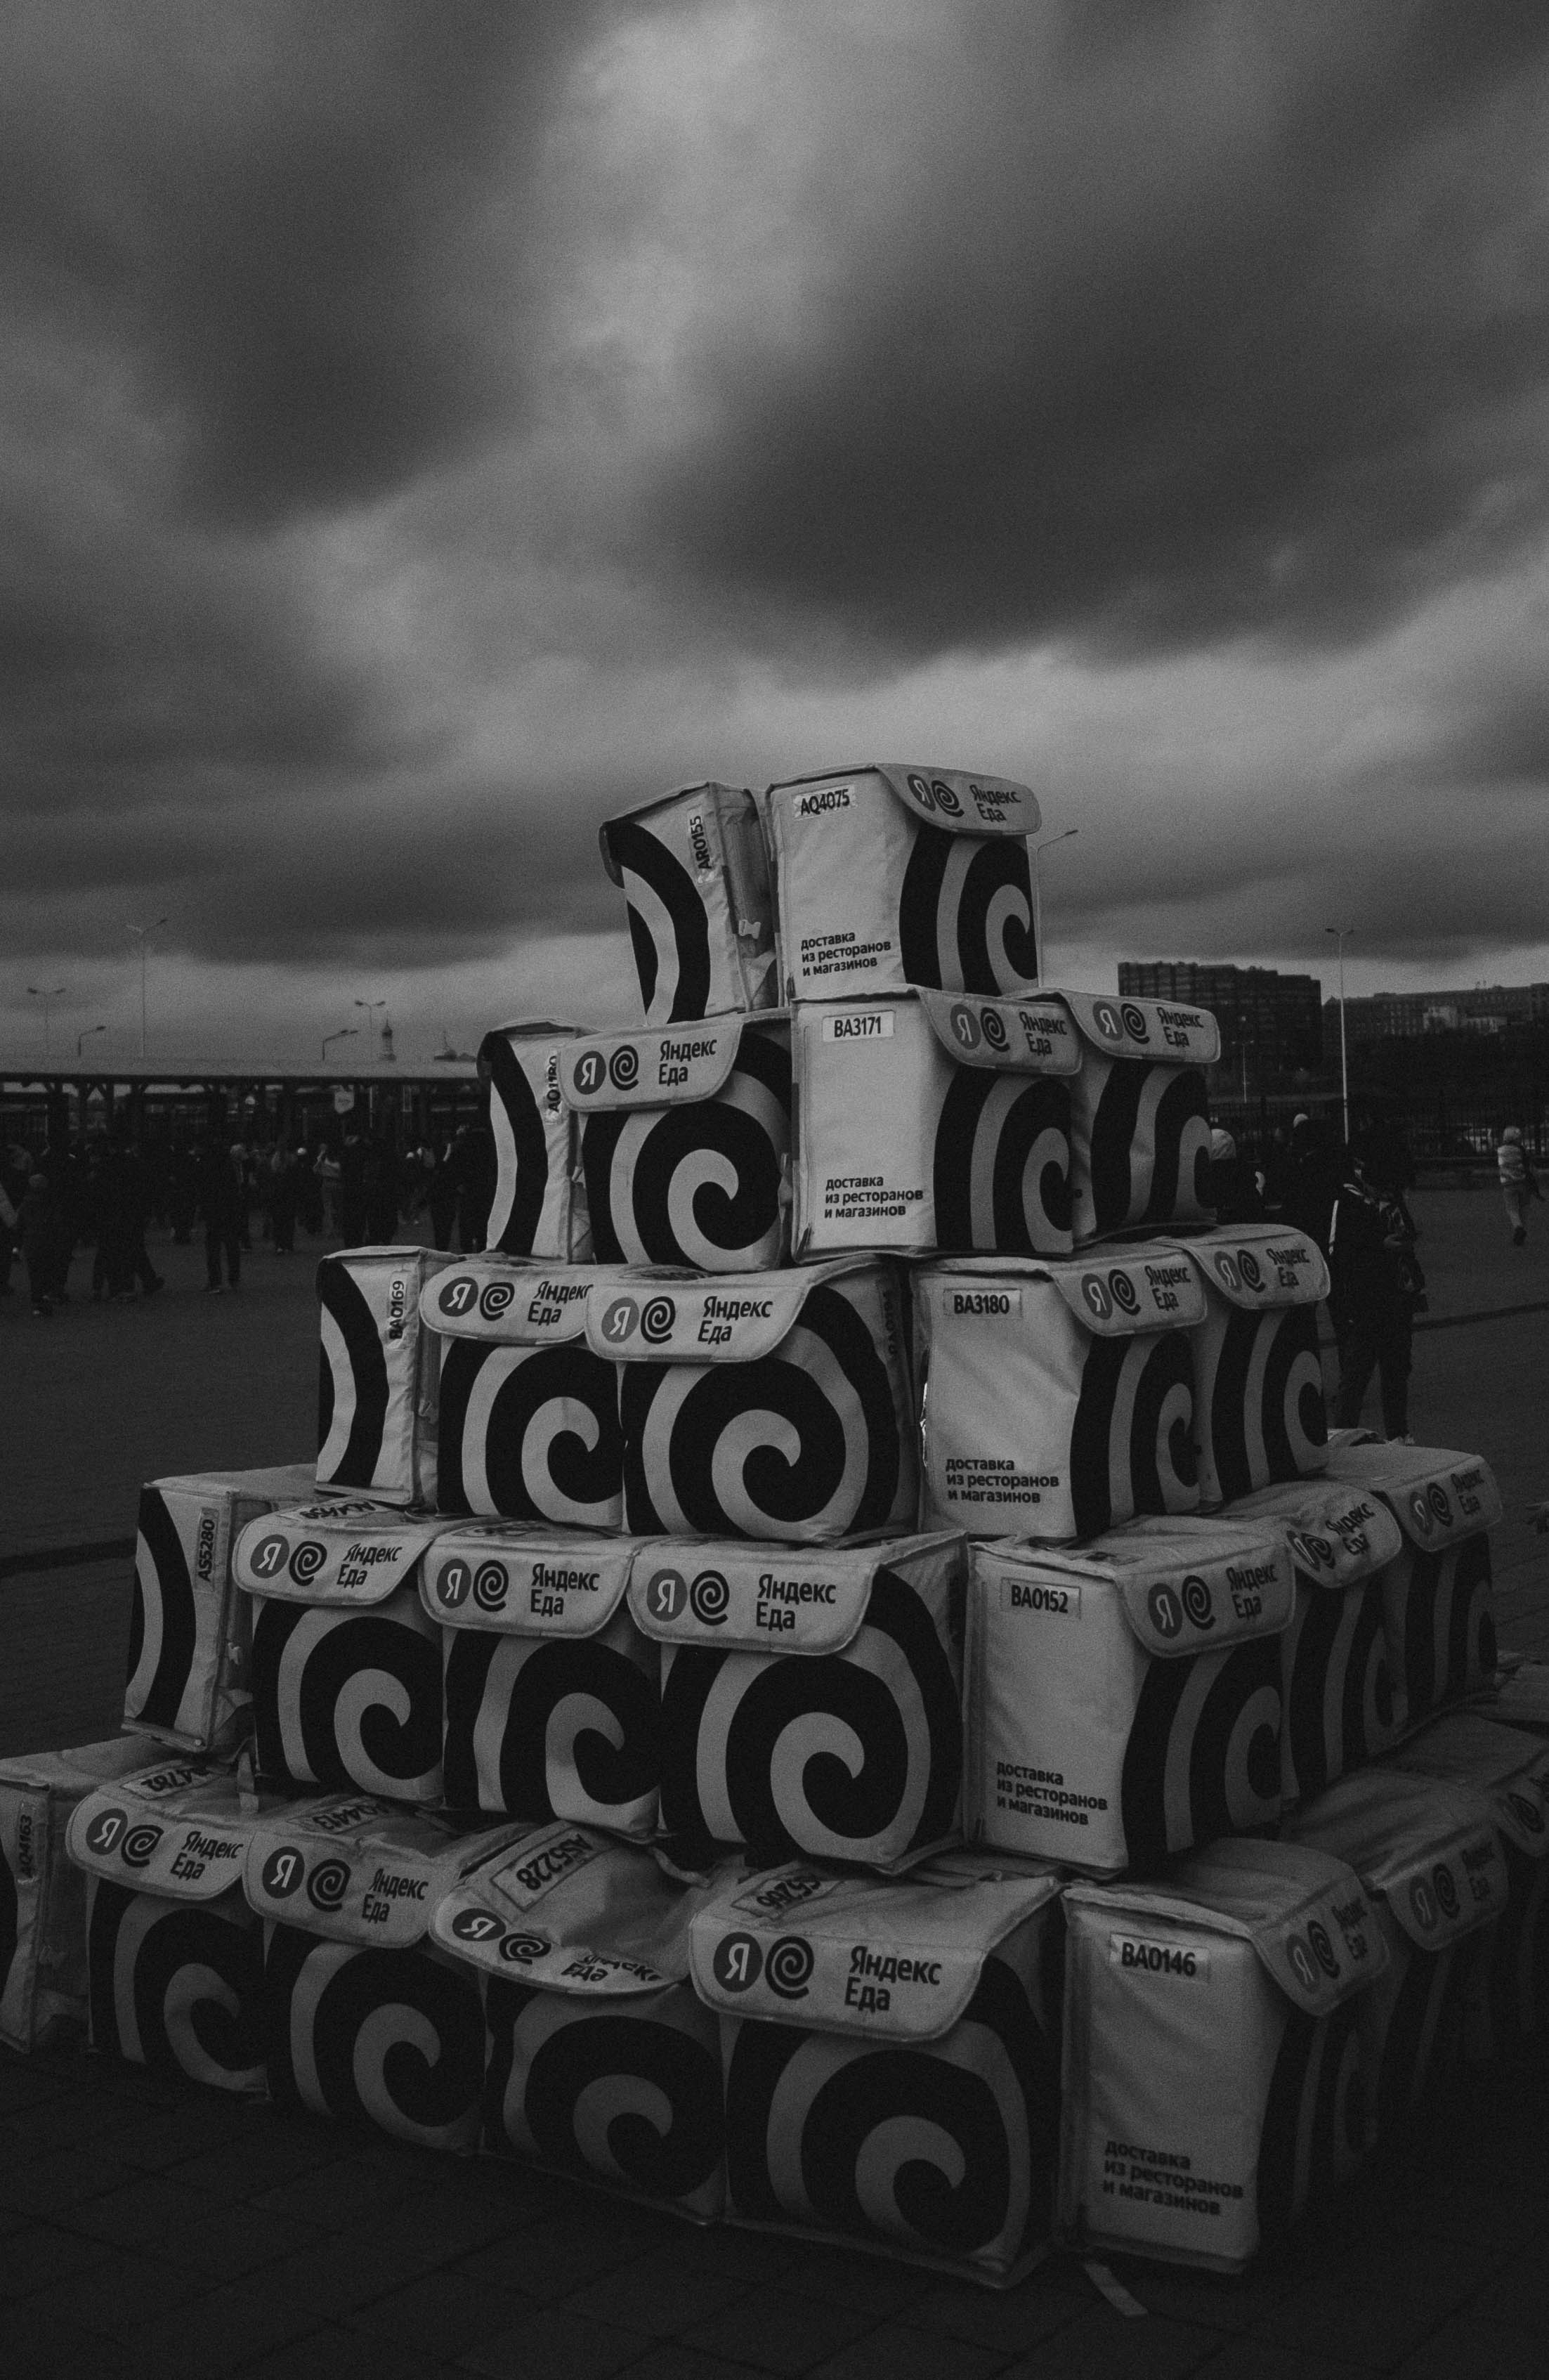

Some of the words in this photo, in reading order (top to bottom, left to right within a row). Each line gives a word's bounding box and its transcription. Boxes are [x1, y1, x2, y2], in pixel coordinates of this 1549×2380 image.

[800, 788, 850, 817] AQ4075
[969, 785, 1021, 807] Яндекс
[979, 806, 1005, 823] Еда
[690, 815, 712, 870] AR0155
[801, 932, 856, 950] доставка
[802, 951, 814, 963] из
[817, 939, 891, 961] ресторанов
[802, 965, 810, 977] и
[812, 956, 877, 975] магазинов
[833, 1016, 882, 1038] BA3171
[1019, 1011, 1068, 1036] Яндекс
[1156, 1007, 1204, 1030] Яндекс
[1027, 1033, 1052, 1054] Еда
[1163, 1026, 1189, 1048] Еда
[659, 1039, 717, 1062] Яндекс
[658, 1063, 688, 1084] Еда
[825, 1176, 884, 1192] доставка
[825, 1192, 839, 1204] из
[842, 1188, 923, 1207] ресторанов
[824, 1207, 832, 1218] и
[835, 1204, 906, 1219] магазинов
[1267, 1247, 1309, 1270] Яндекс
[1144, 1266, 1191, 1290] Яндекс
[1279, 1268, 1300, 1287] Еда
[703, 1296, 773, 1321] Яндекс
[954, 1294, 1009, 1314] BA3180
[1152, 1288, 1179, 1311] Еда
[528, 1301, 562, 1326] Еда
[698, 1321, 732, 1344] Еда
[946, 1457, 1015, 1473] доставка
[947, 1474, 962, 1487] из
[967, 1474, 1059, 1491] ресторанов
[948, 1490, 957, 1501] и
[961, 1490, 1040, 1504] магазинов
[199, 1519, 215, 1582] AS5280
[344, 1543, 404, 1566] Яндекс
[336, 1563, 367, 1587] Еда
[531, 1563, 600, 1594] Яндекс
[1226, 1561, 1278, 1597] Яндекс
[757, 1574, 837, 1604] Яндекс
[1011, 1585, 1068, 1613] BA0152
[530, 1589, 564, 1616] Еда
[1234, 1594, 1262, 1620] Еда
[756, 1601, 796, 1631] Еда
[997, 1761, 1064, 1786] доставка
[997, 1779, 1013, 1793] из
[1017, 1782, 1108, 1811] ресторанов
[997, 1794, 1006, 1807] и
[1009, 1797, 1089, 1826] магазинов
[183, 1830, 244, 1860] Яндекс
[170, 1855, 206, 1880] Еда
[367, 1868, 429, 1900] Яндекс
[361, 1897, 391, 1923] Еда
[851, 1946, 943, 1986] Яндекс
[1121, 1942, 1197, 1977] BA0146
[844, 1977, 890, 2012] Еда
[1105, 2140, 1191, 2171] доставка
[1104, 2159, 1124, 2176] из
[1129, 2164, 1244, 2202] ресторанов
[1102, 2180, 1115, 2195] и
[1119, 2180, 1222, 2216] магазинов
